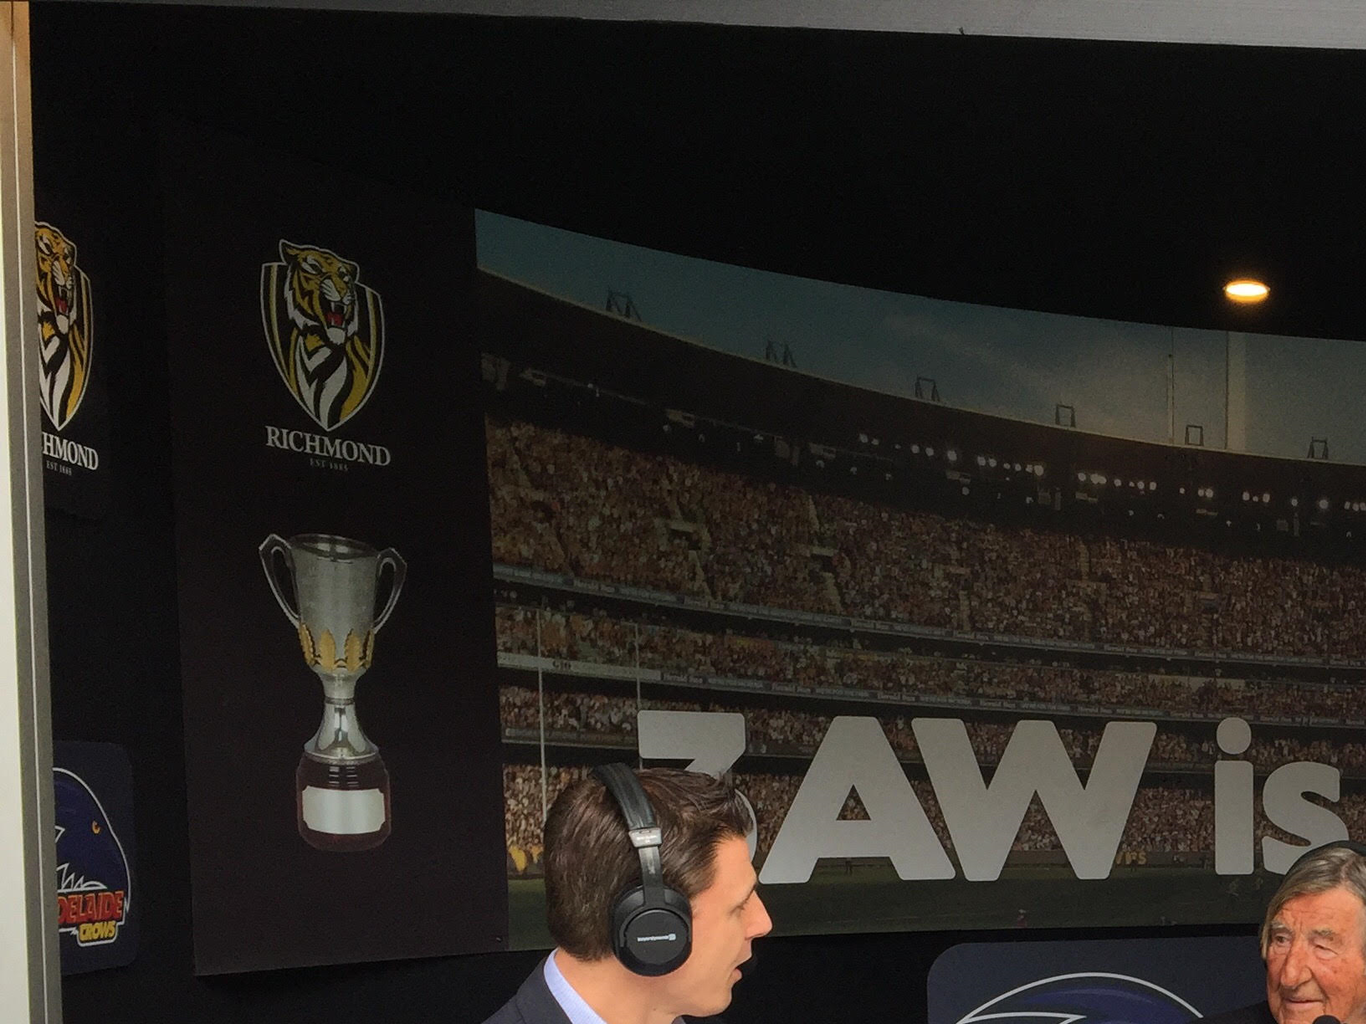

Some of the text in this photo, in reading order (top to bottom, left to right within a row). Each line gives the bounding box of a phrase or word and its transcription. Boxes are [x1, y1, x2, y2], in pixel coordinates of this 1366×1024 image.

[265, 425, 391, 467] RICHMOND
[1214, 716, 1350, 876] is
[79, 920, 117, 942] CROWS
